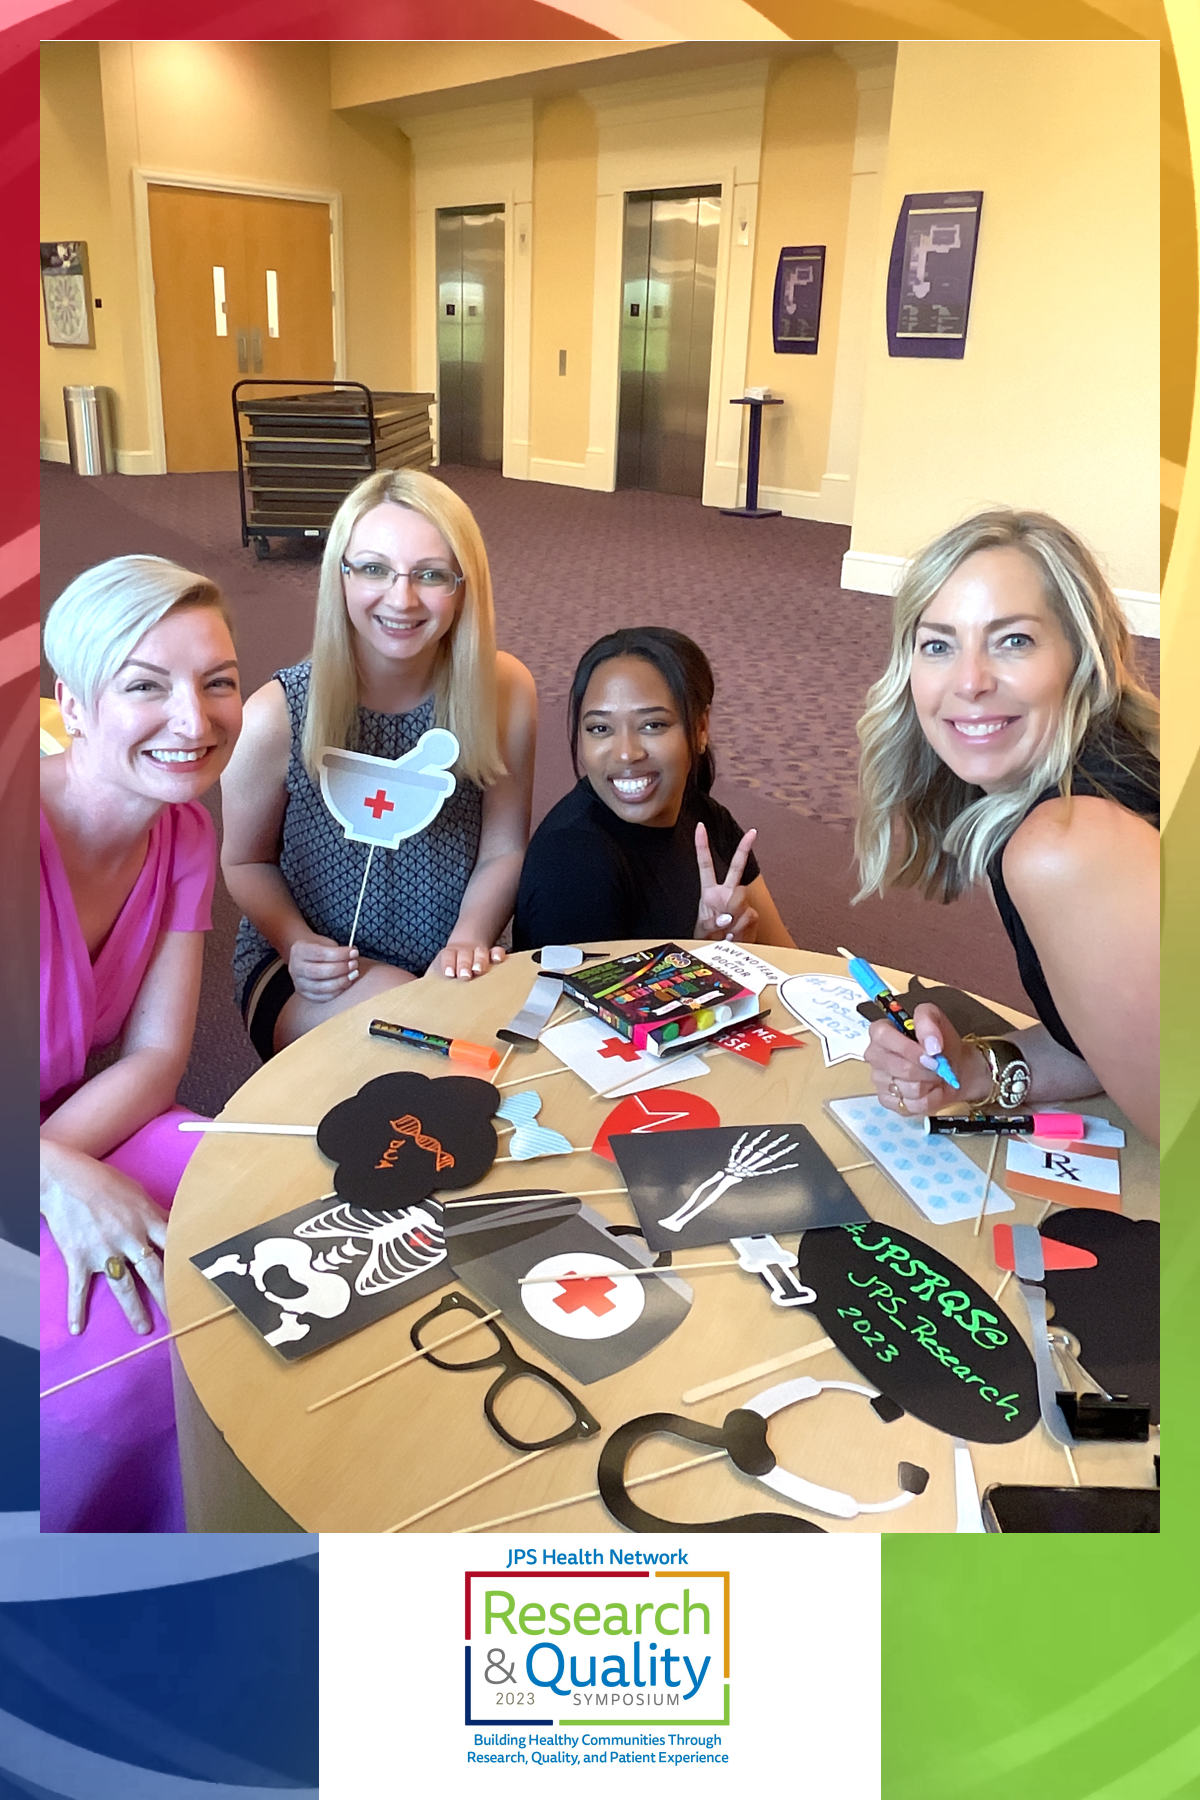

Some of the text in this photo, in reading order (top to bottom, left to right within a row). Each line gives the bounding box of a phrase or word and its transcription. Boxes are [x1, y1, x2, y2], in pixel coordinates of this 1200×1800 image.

[711, 955, 751, 978] DOCTOR
[714, 945, 779, 981] HAVE NO FEAR
[805, 976, 863, 1002] #JPS
[816, 1016, 862, 1040] 2023
[837, 1307, 900, 1363] 2023
[847, 1271, 1020, 1423] JPS_Research
